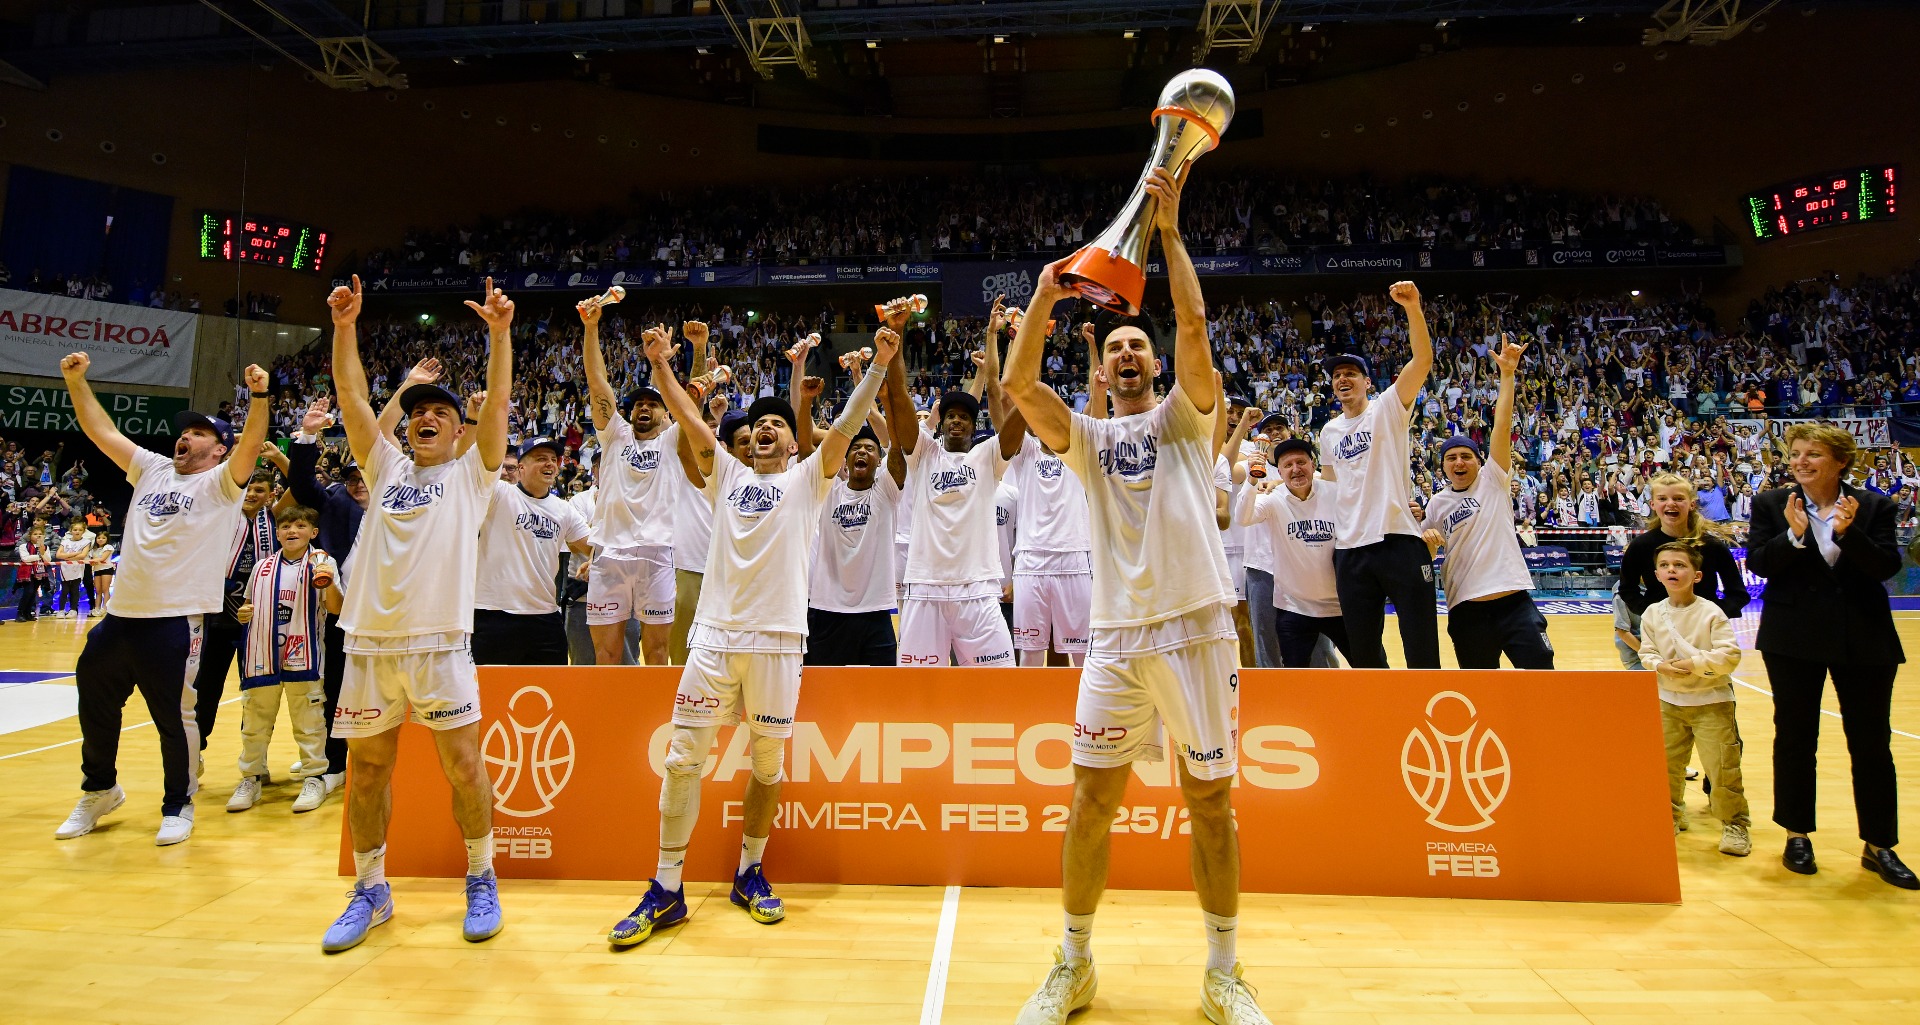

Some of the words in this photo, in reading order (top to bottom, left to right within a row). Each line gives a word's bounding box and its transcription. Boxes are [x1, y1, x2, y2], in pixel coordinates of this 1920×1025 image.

[1795, 187, 1808, 197] 85
[1833, 180, 1846, 190] 68
[244, 222, 257, 231] 85
[277, 227, 290, 237] 68
[1341, 256, 1402, 268] dinahosting
[1553, 251, 1592, 264] enova
[1605, 250, 1645, 263] enova
[867, 265, 897, 273] Británico
[392, 277, 433, 288] Fundación
[982, 269, 1031, 291] OBRA
[982, 283, 1032, 303] DOIRO
[4, 334, 55, 347] MINERAL
[58, 341, 109, 353] NATURAL
[112, 346, 126, 354] DE
[129, 348, 170, 357] GALICIA
[7, 386, 75, 408] SAID
[113, 395, 150, 413] DE
[3, 410, 171, 436] MERXCIA
[1288, 521, 1297, 536] EU
[1297, 519, 1313, 531] NON
[587, 602, 619, 612] BYD
[901, 653, 939, 665] BYD
[1229, 673, 1238, 692] 9
[676, 693, 720, 708] BYD
[334, 706, 382, 720] BYD
[434, 702, 472, 719] MONBUS
[760, 715, 793, 724] MONBU
[1073, 722, 1128, 741] BYD
[941, 804, 1030, 832] FEB
[491, 826, 553, 837] PRIMERA
[491, 837, 553, 859] FEB
[1425, 841, 1498, 853] PRIMERA
[1427, 854, 1501, 878] FEB
